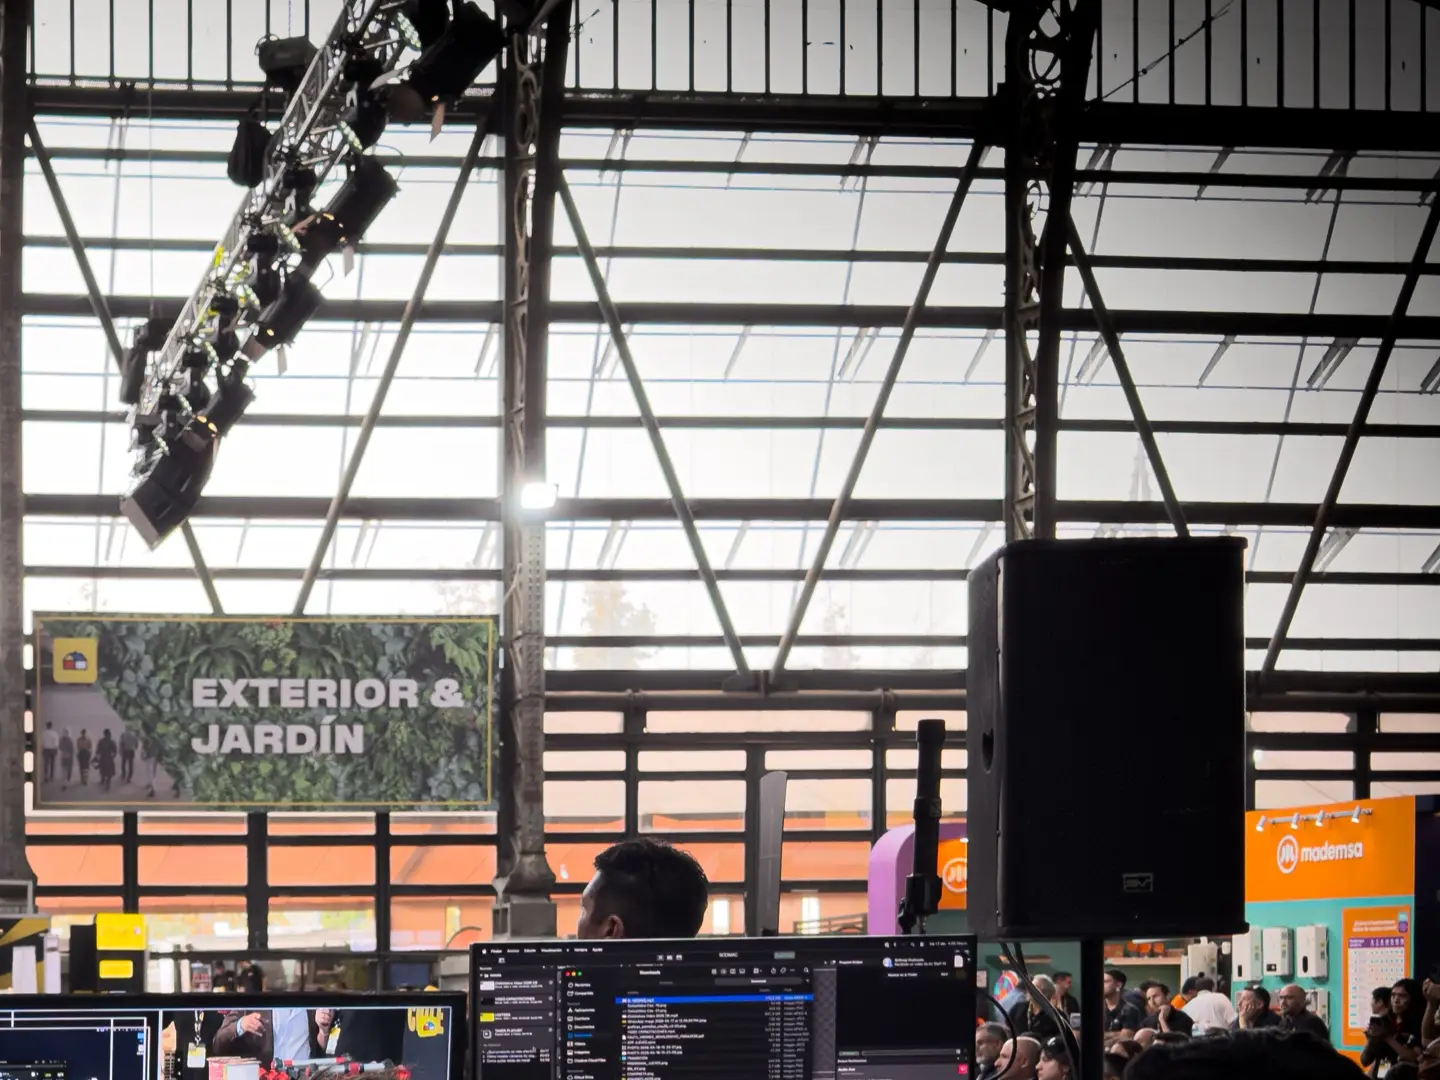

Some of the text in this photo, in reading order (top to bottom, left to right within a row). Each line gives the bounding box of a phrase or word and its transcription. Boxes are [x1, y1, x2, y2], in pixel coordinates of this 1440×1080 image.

[192, 678, 464, 709] EXTERIOR &
[191, 715, 364, 754] JARDÍN
[1301, 841, 1364, 862] mademsa
